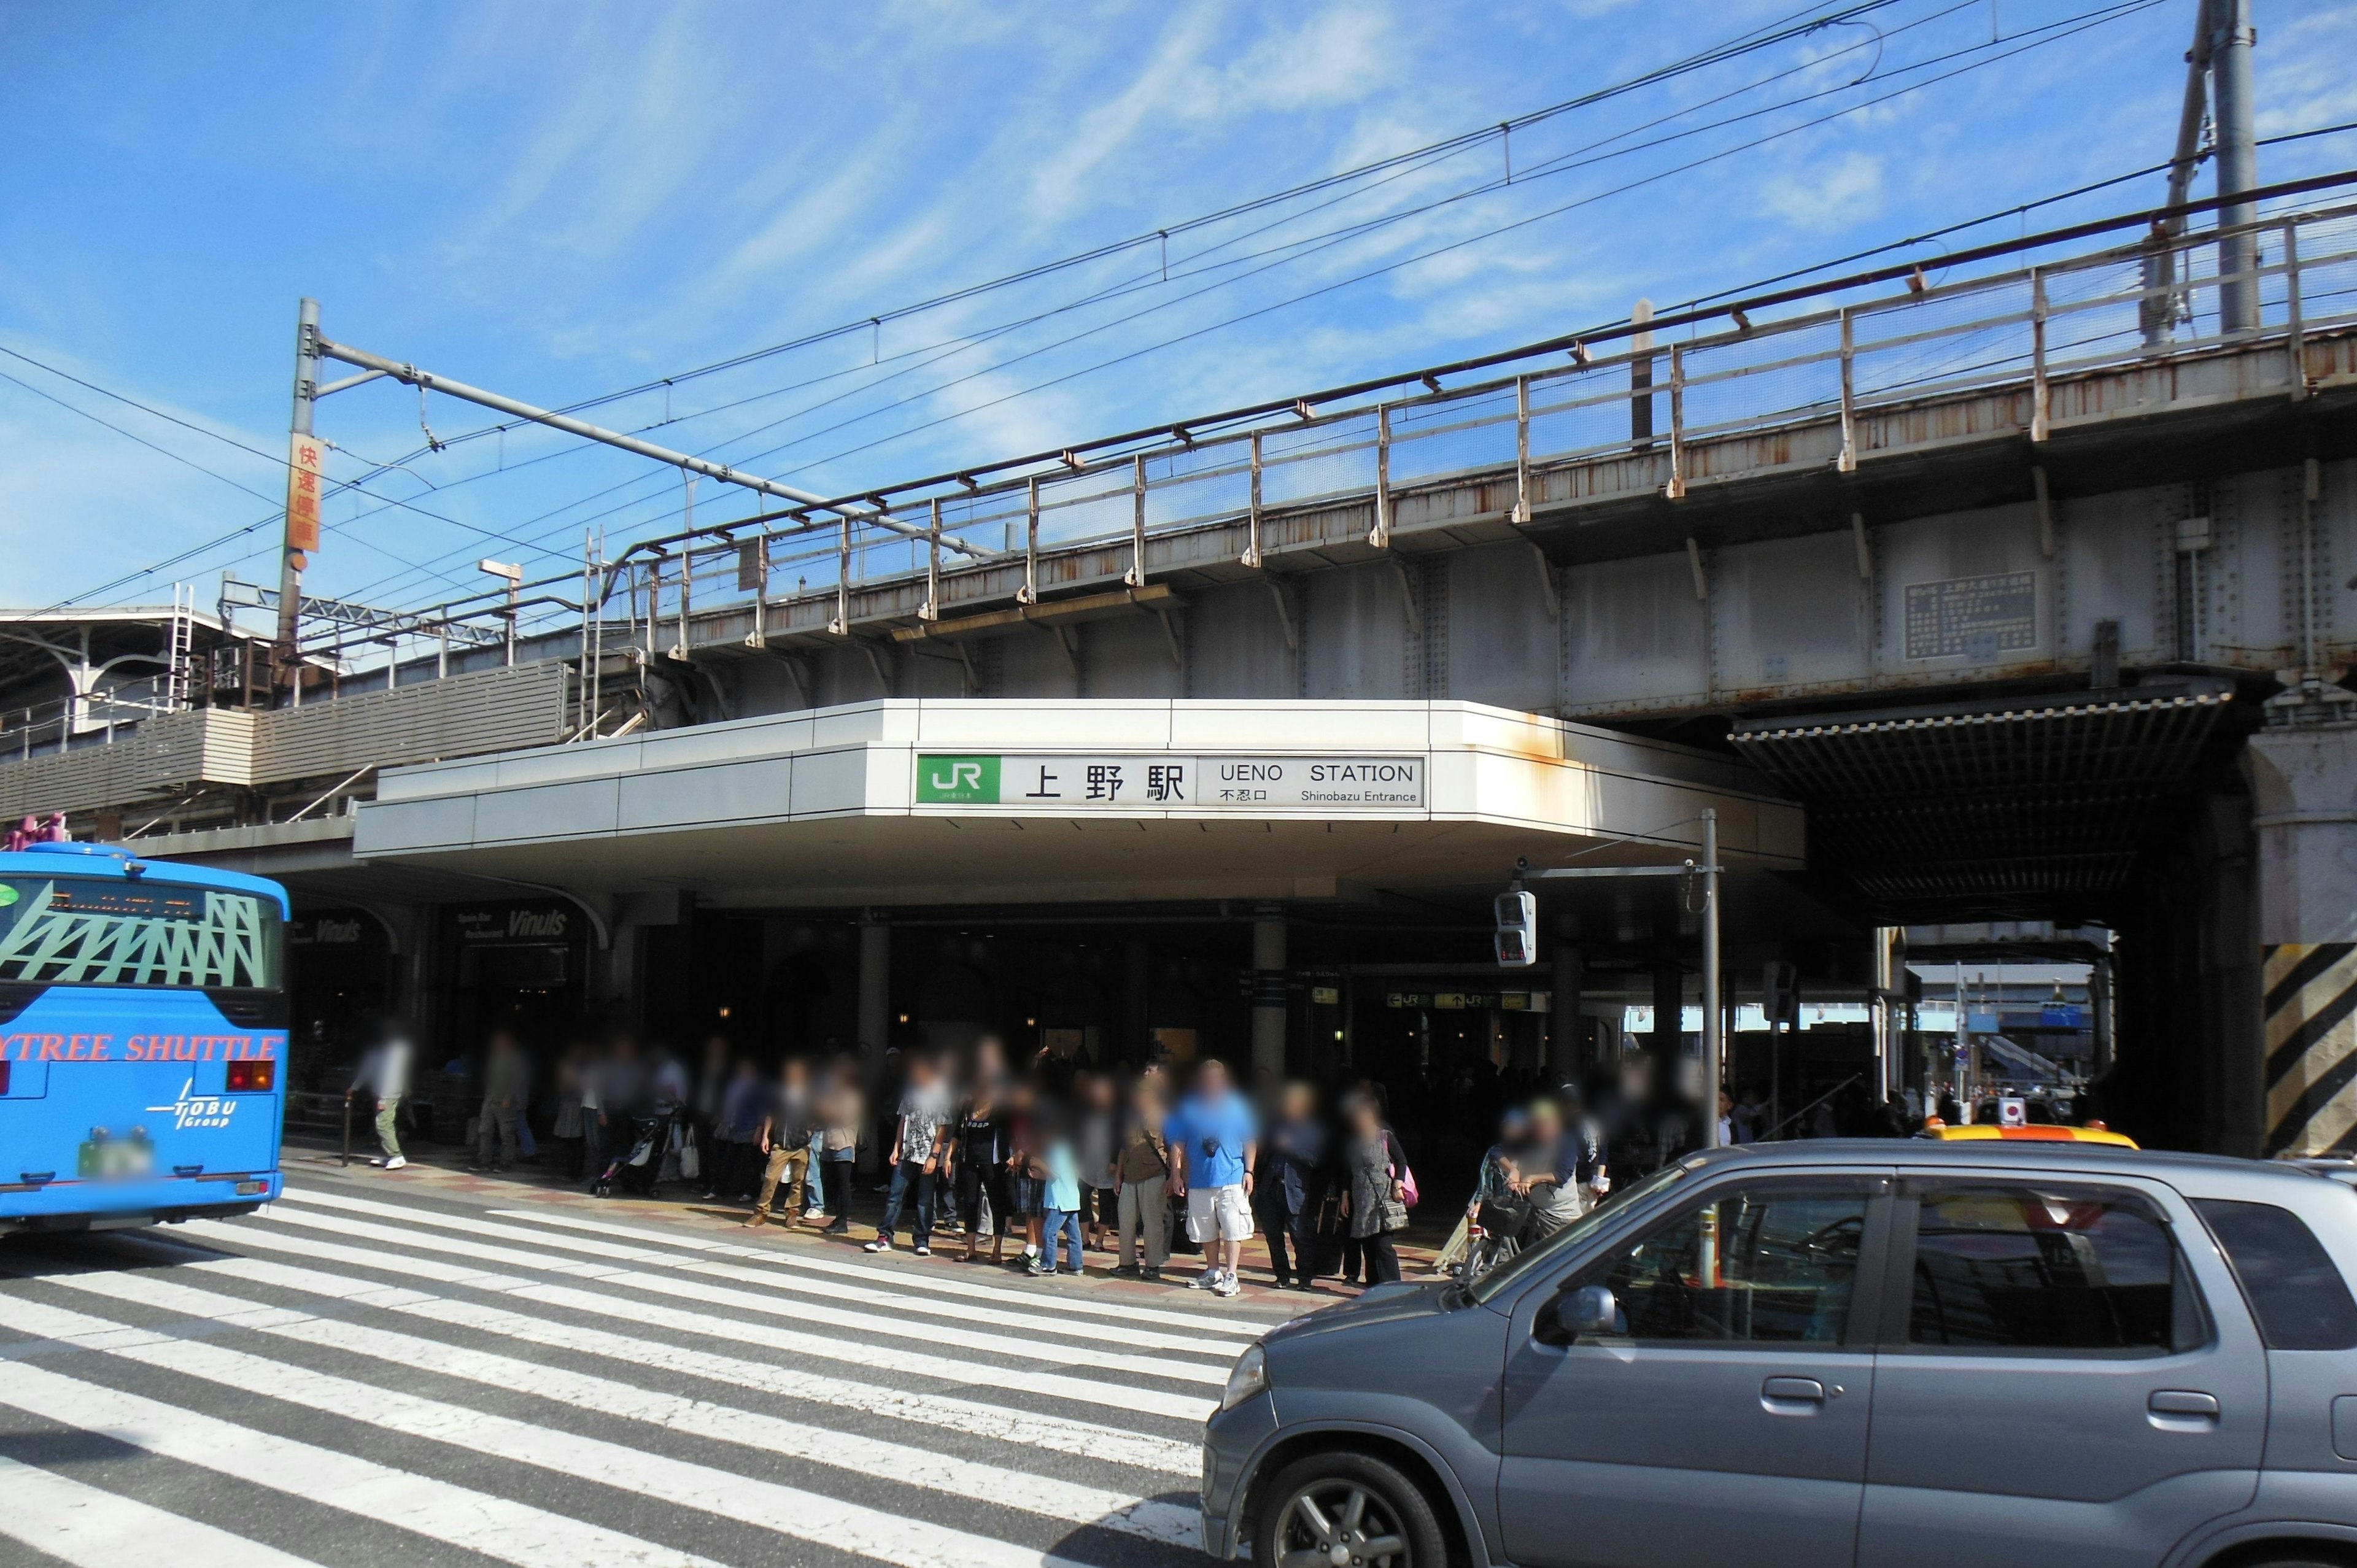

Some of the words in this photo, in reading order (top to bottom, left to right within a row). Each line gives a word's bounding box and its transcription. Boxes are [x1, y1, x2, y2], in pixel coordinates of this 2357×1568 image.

[932, 763, 981, 789] JR
[1221, 765, 1283, 781] UENO
[1310, 765, 1413, 782] STATION
[1026, 765, 1185, 801] 上野駅
[1219, 789, 1267, 801] 不忍口
[1301, 790, 1361, 801] Shinobazu
[1364, 791, 1417, 801] Entrance
[174, 1100, 237, 1116] TOBU
[185, 1116, 230, 1128] Group
